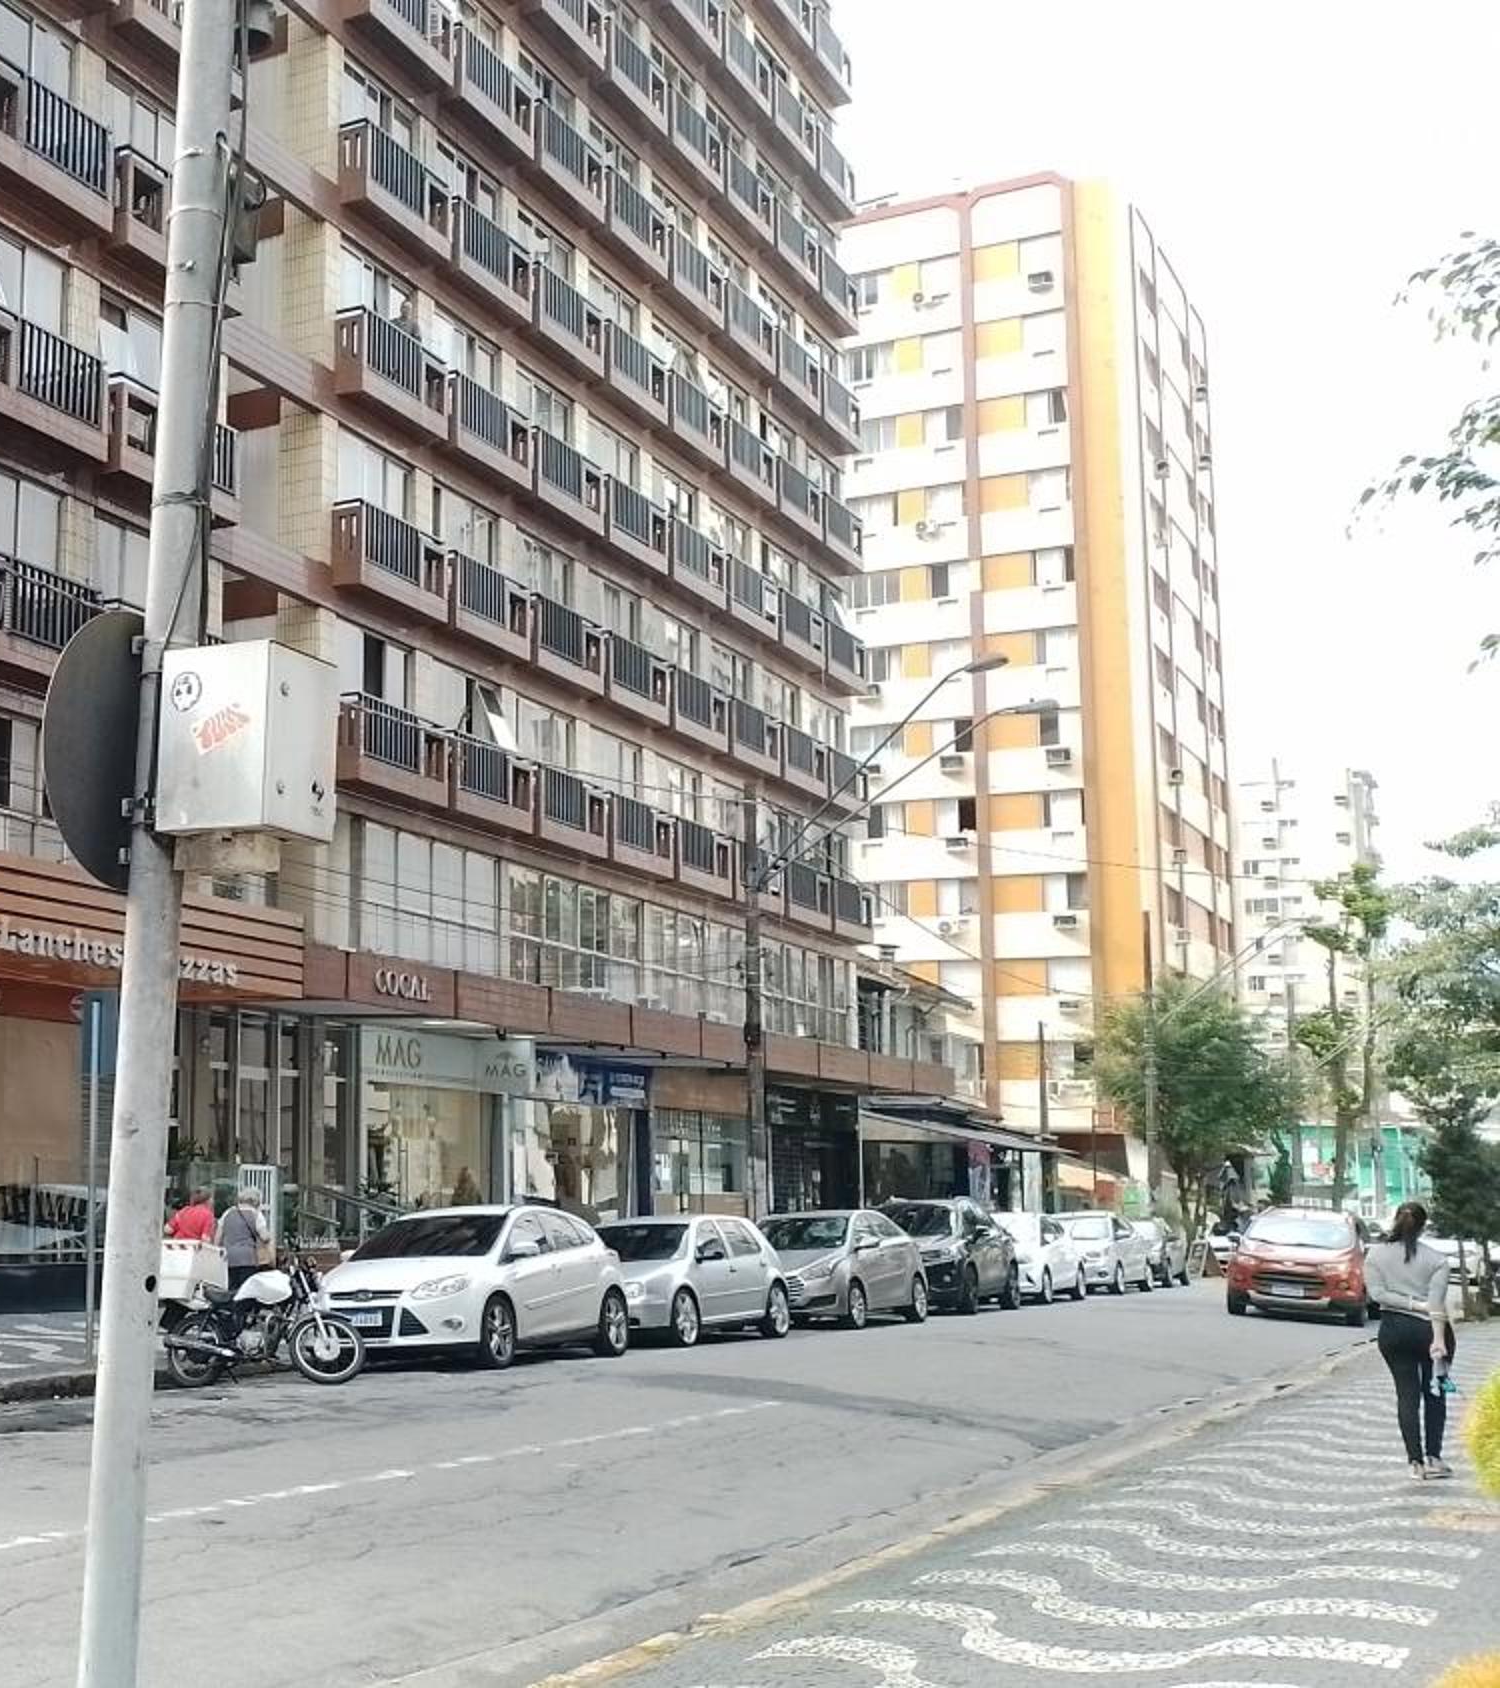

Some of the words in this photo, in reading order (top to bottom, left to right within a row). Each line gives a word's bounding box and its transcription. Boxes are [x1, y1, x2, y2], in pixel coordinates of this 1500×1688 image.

[179, 954, 239, 987] zzas
[375, 968, 431, 1002] COCAL
[375, 1035, 421, 1069] MAG
[485, 1063, 527, 1079] MAG
